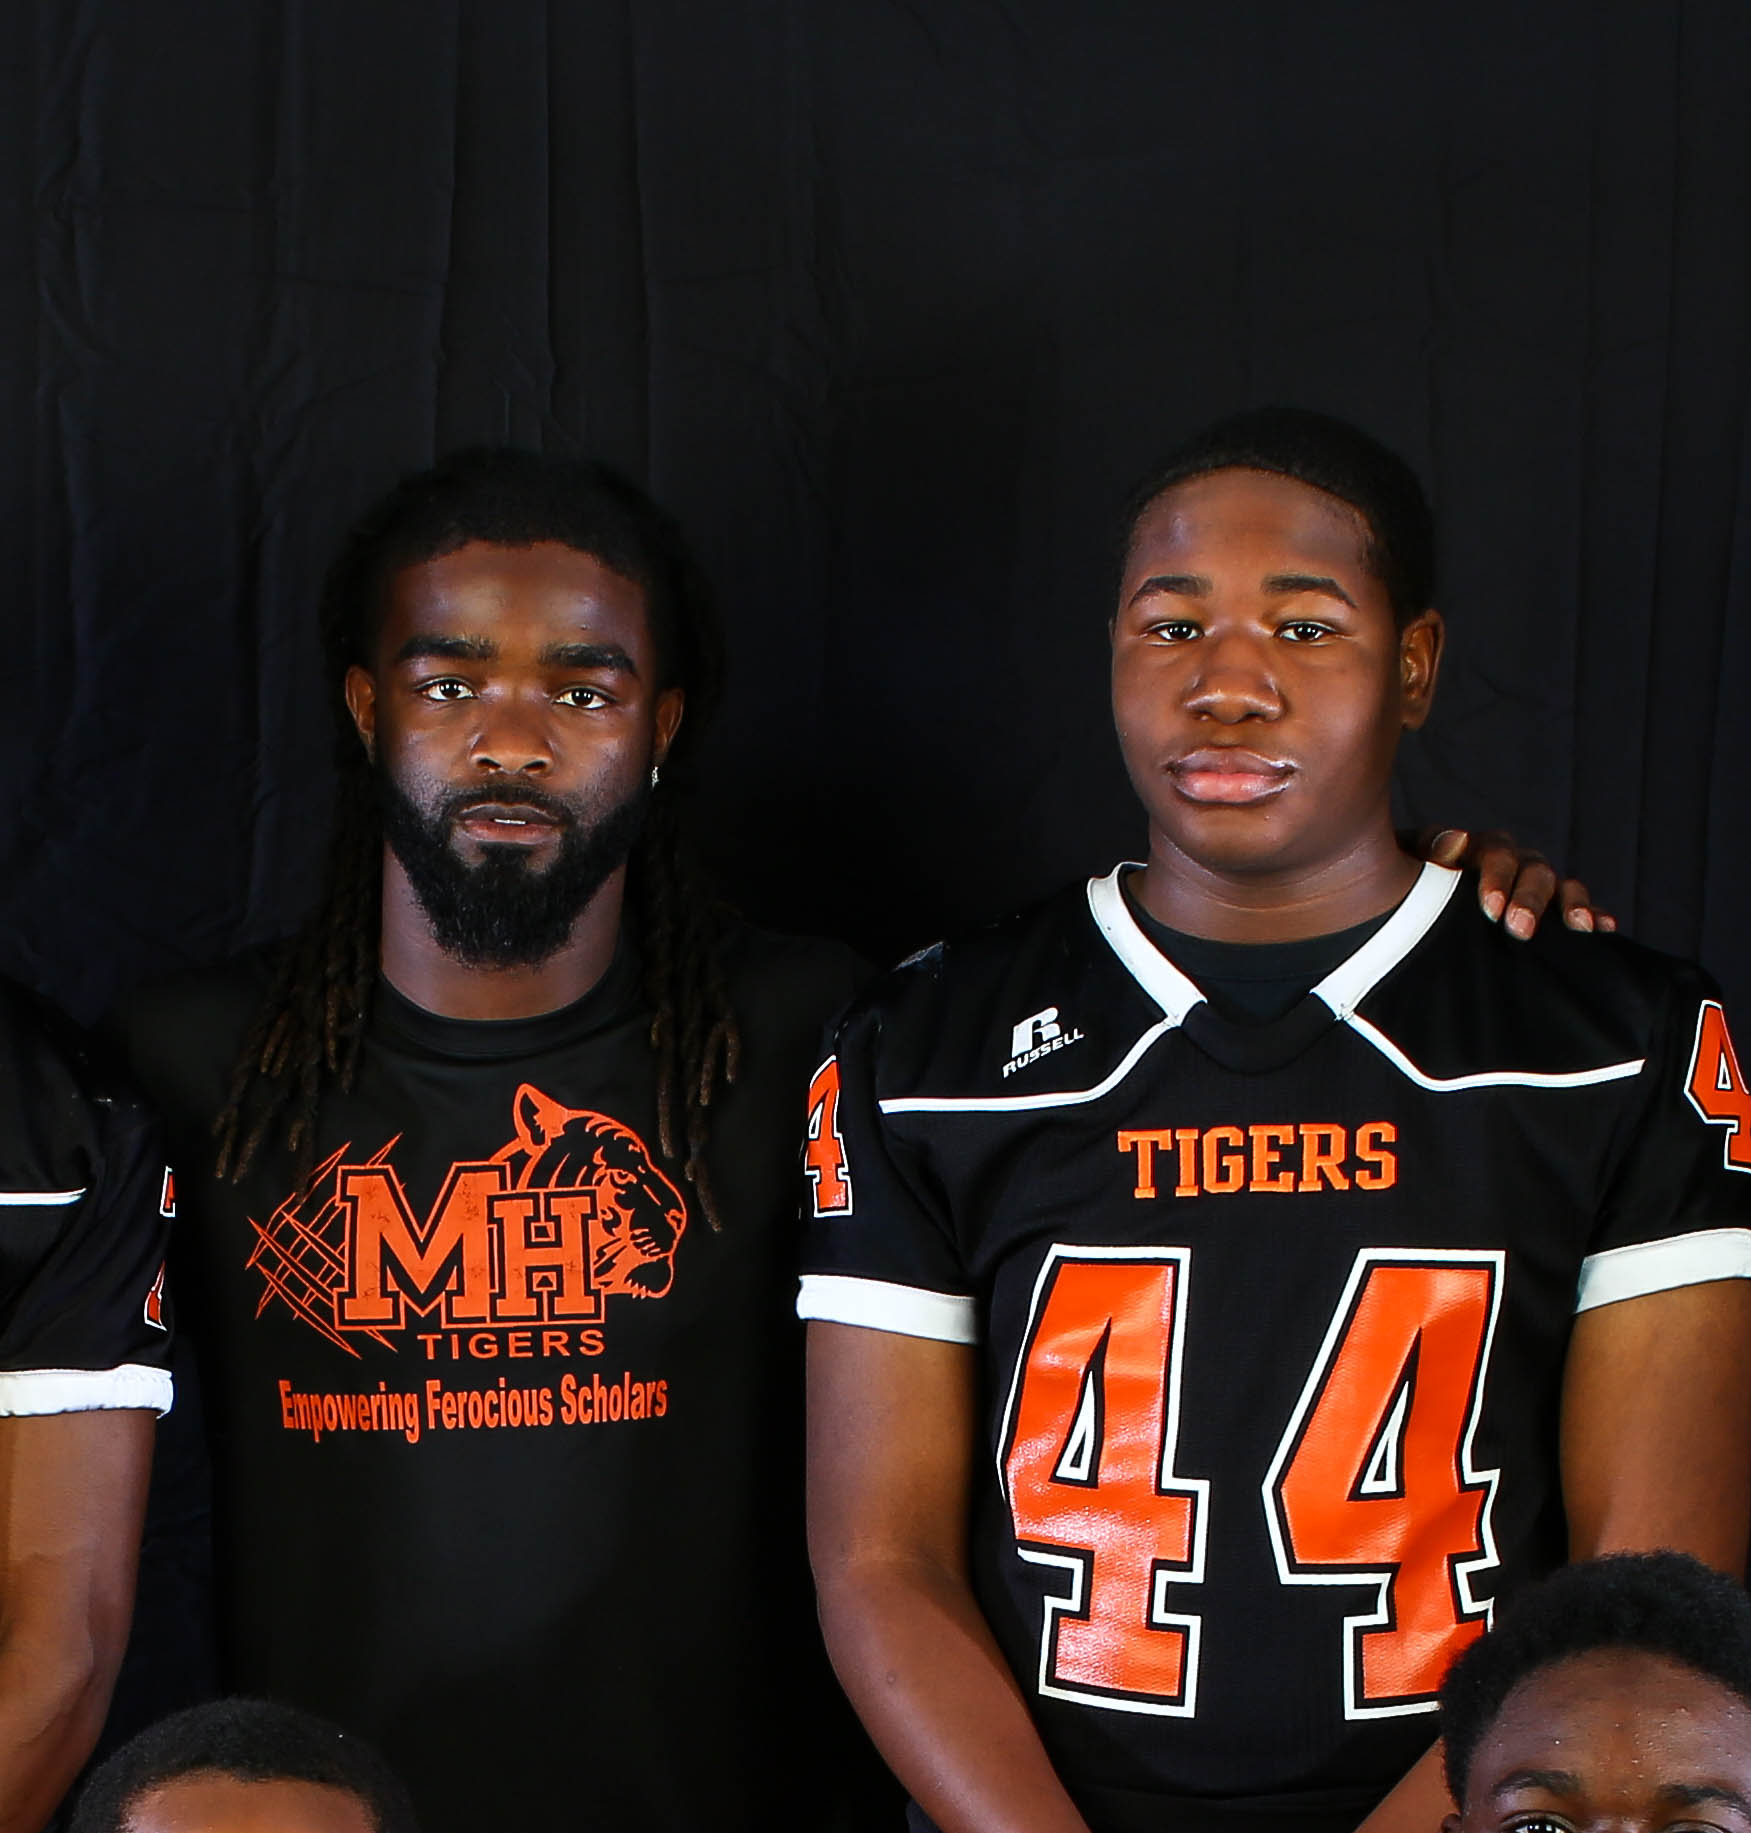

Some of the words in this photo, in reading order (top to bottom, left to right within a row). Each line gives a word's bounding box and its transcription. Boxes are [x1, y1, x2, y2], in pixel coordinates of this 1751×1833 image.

[1003, 1028, 1084, 1078] RUSSELL
[1118, 1121, 1397, 1199] TIGERS
[335, 1160, 605, 1330] MH
[416, 1328, 605, 1361] TIGERS
[278, 1379, 420, 1444] Empowering
[425, 1377, 554, 1430] Ferocious
[560, 1371, 668, 1425] Scholars
[996, 1243, 1508, 1721] 44
